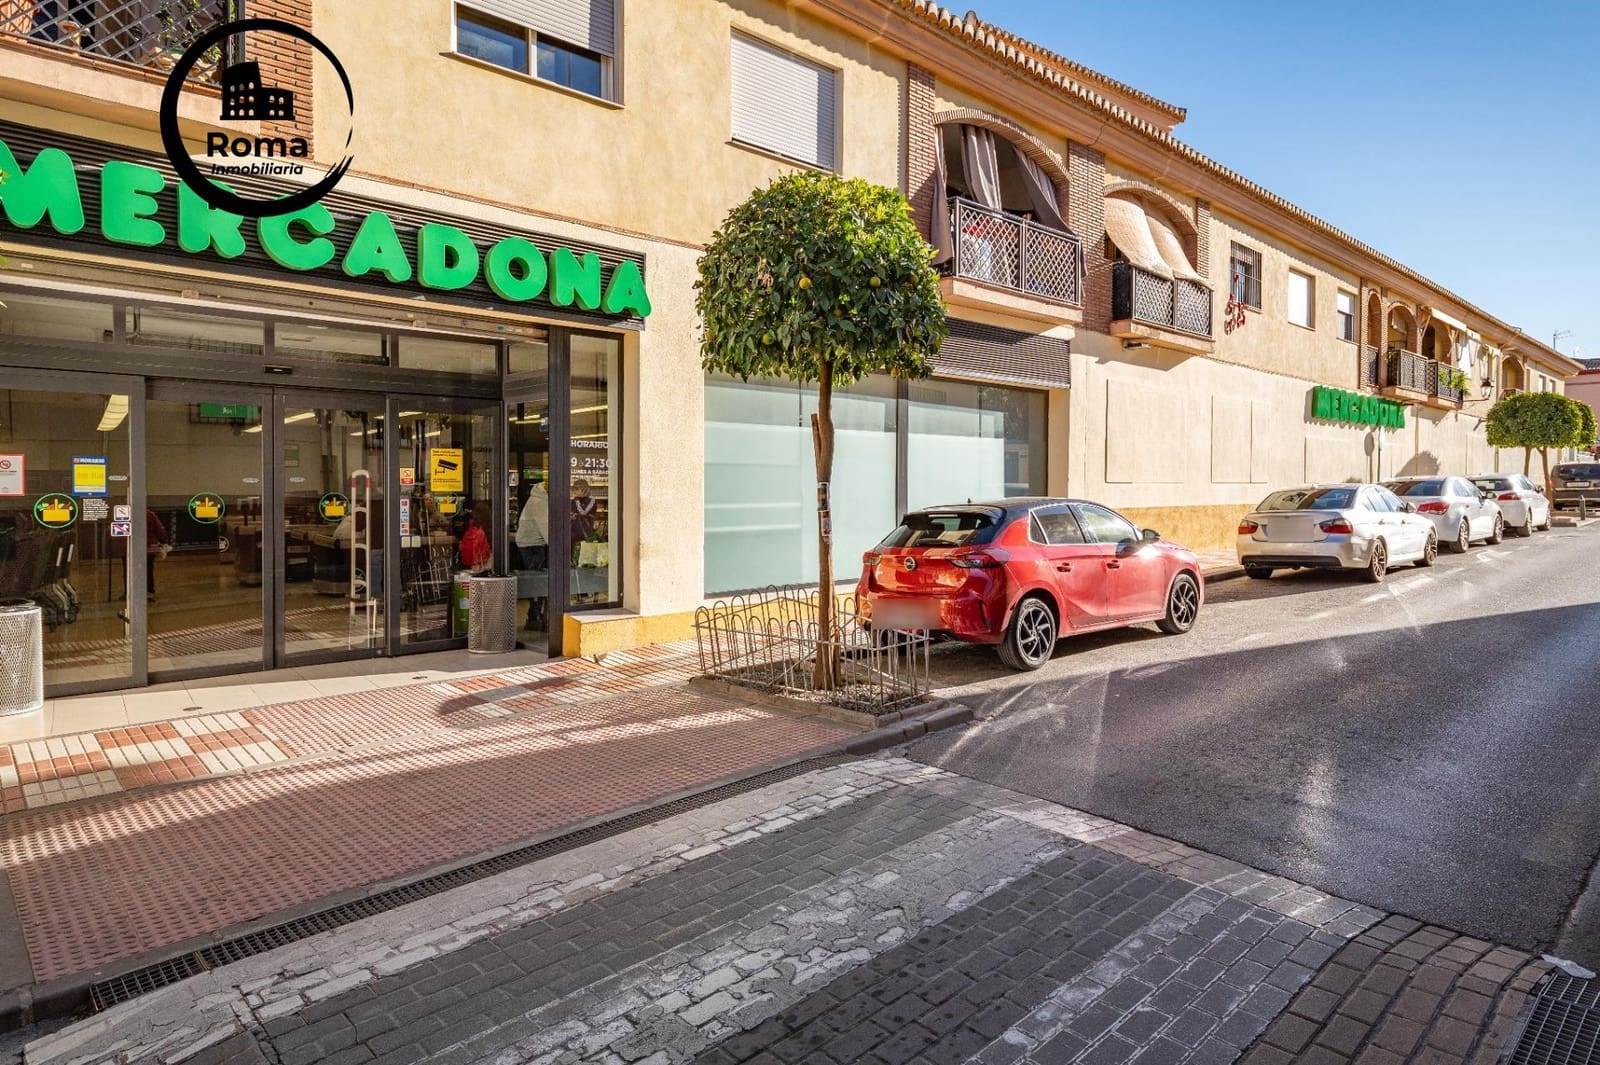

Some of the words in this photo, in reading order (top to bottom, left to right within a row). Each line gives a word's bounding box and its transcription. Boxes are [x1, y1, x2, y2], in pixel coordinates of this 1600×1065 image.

[0, 139, 651, 318] MERCADONA
[1314, 385, 1405, 429] MERCADONA
[570, 440, 608, 448] HORARIO
[570, 457, 577, 467] 9
